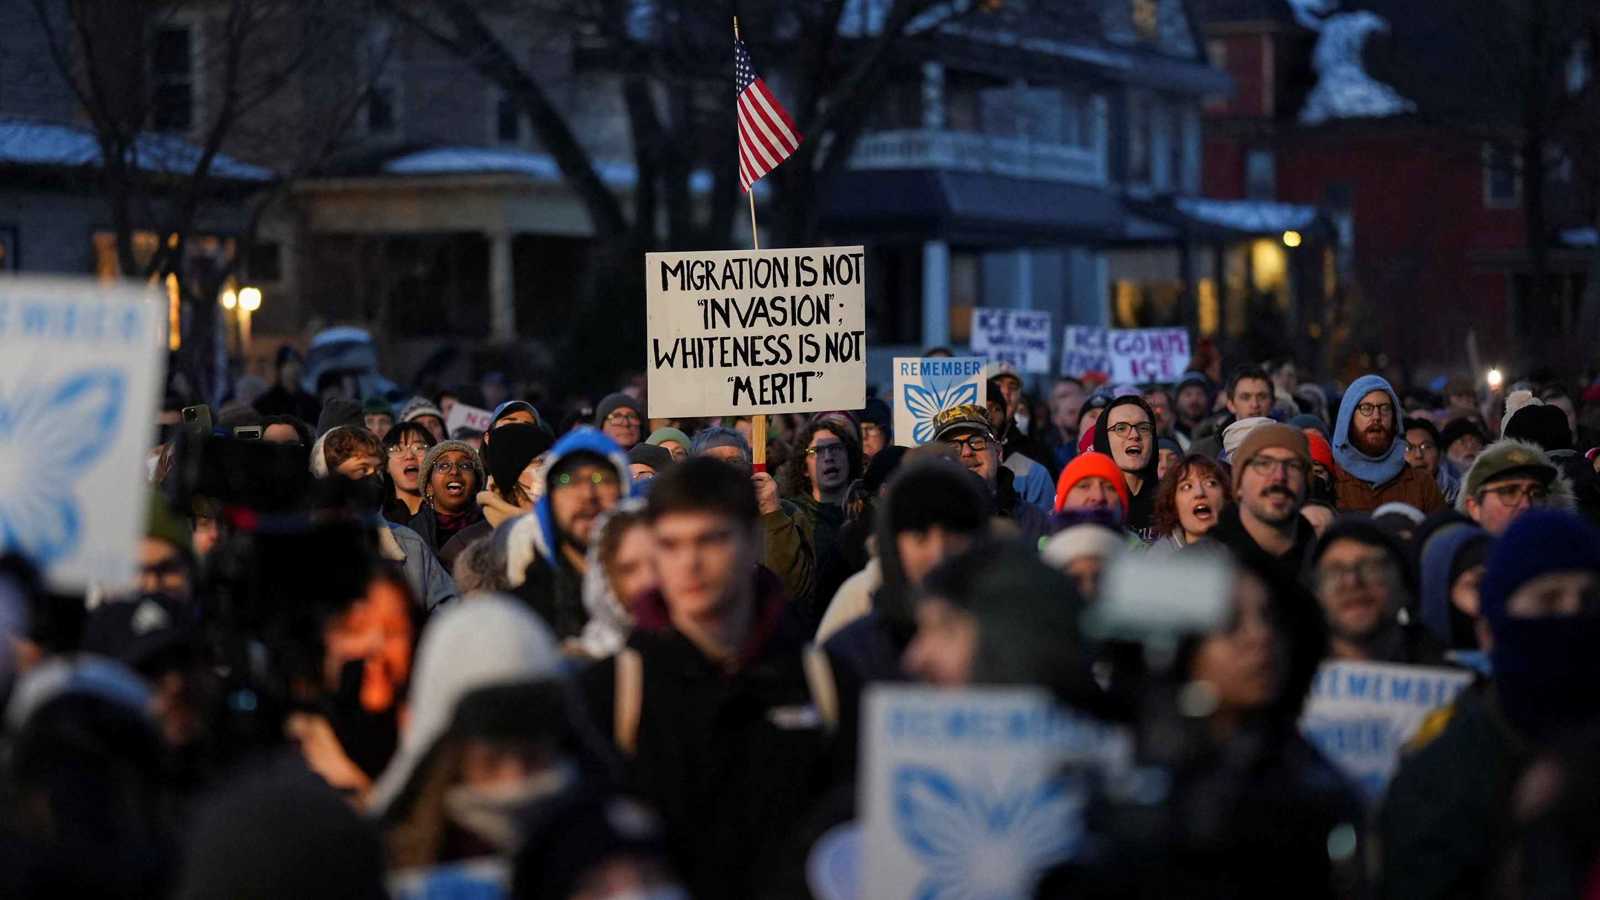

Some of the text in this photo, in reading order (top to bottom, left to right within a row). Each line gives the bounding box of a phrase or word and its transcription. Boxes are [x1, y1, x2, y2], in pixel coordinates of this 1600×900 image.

[661, 253, 863, 291] MIGRATION IS NOT
[653, 331, 864, 369] WHITENESS IS NOT
[900, 361, 980, 376] REMEMBER
